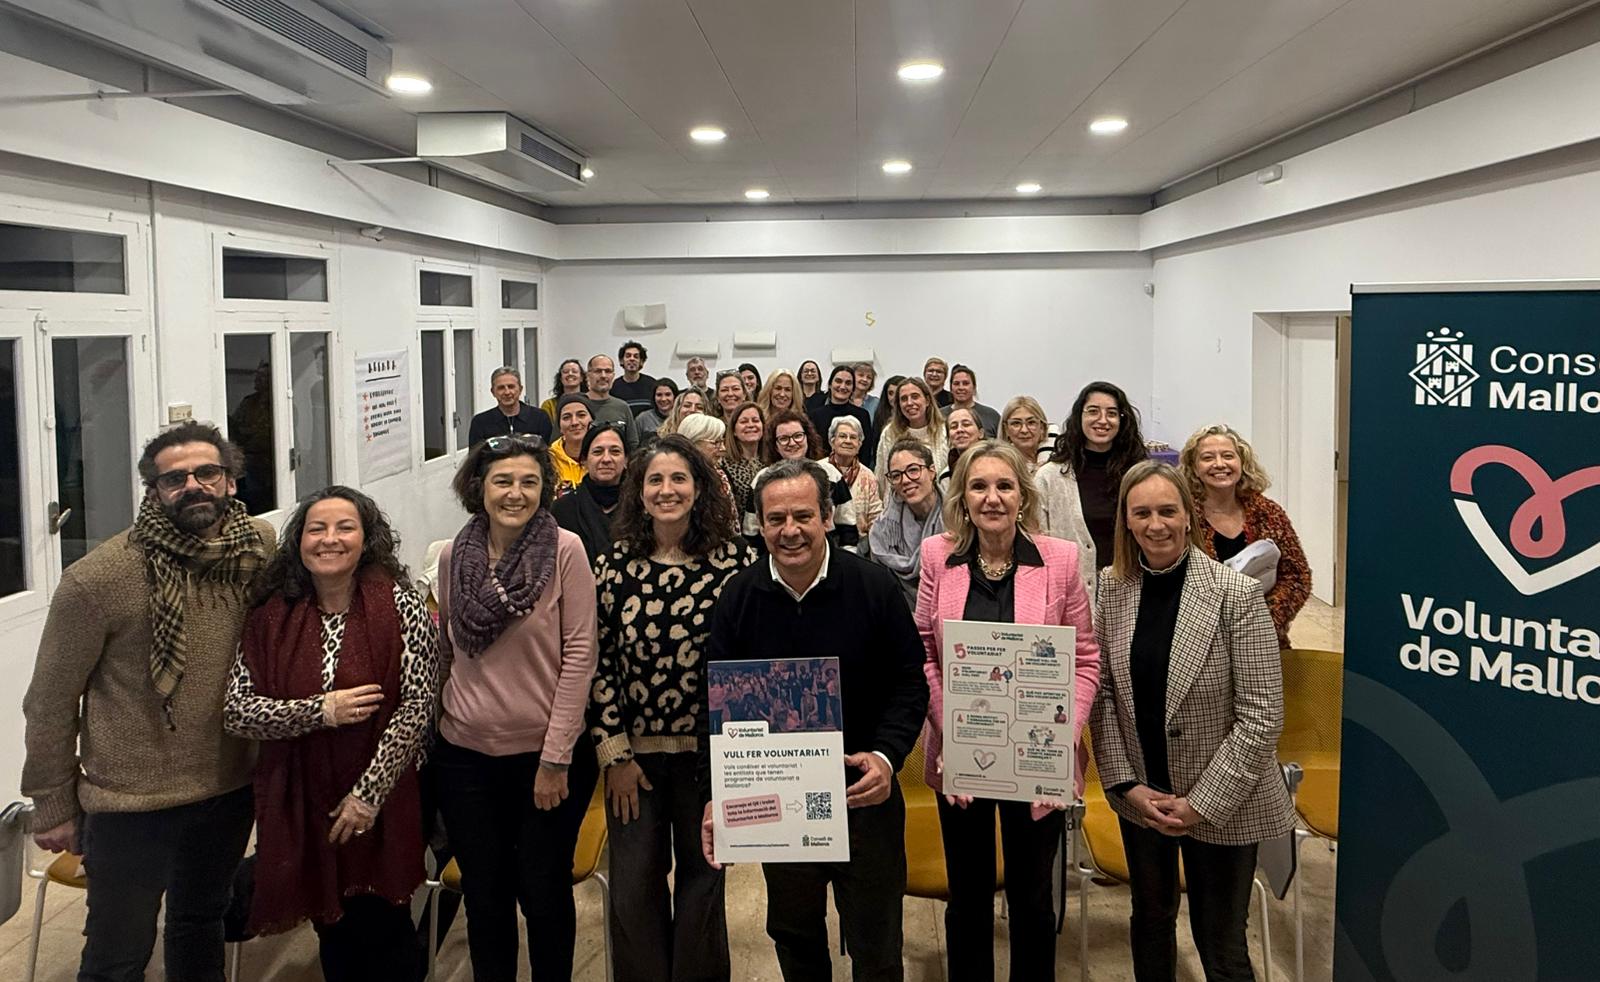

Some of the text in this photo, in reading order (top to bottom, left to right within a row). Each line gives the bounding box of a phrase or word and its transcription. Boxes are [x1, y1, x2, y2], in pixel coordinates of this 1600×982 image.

[1490, 346, 1600, 376] Cons
[1489, 381, 1600, 414] Mallo
[1400, 593, 1600, 661] Volunta
[954, 643, 966, 659] 5
[1019, 657, 1025, 665] 1
[953, 667, 960, 676] 2
[1400, 635, 1600, 705] de Mallo
[1018, 690, 1024, 698] 3
[957, 714, 963, 723] 4
[764, 749, 829, 758] VOLUNTARIAT!
[1018, 748, 1024, 756] 5
